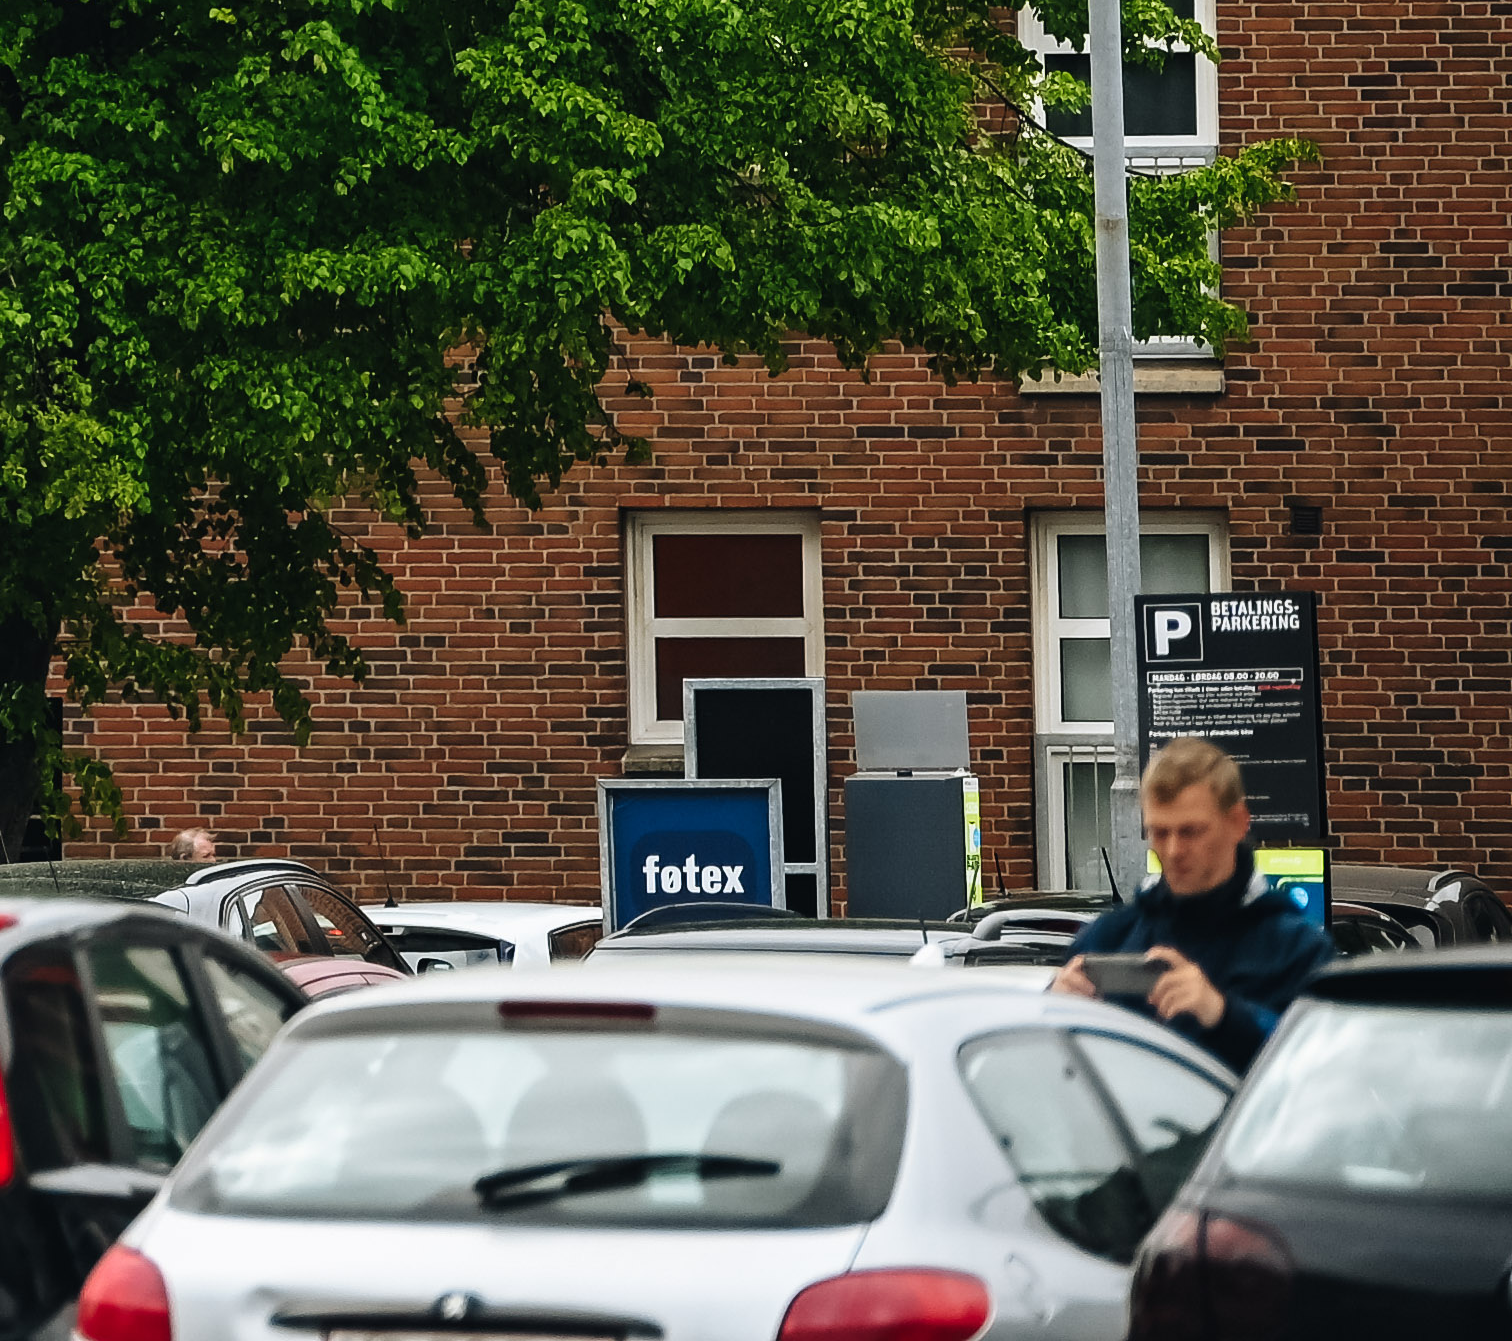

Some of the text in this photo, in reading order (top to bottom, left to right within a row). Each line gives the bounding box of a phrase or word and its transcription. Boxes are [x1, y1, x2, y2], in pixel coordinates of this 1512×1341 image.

[1211, 600, 1299, 616] BETALINGS-
[1155, 611, 1191, 656] P
[1212, 615, 1299, 632] PARKERING
[643, 853, 745, 894] føtex
